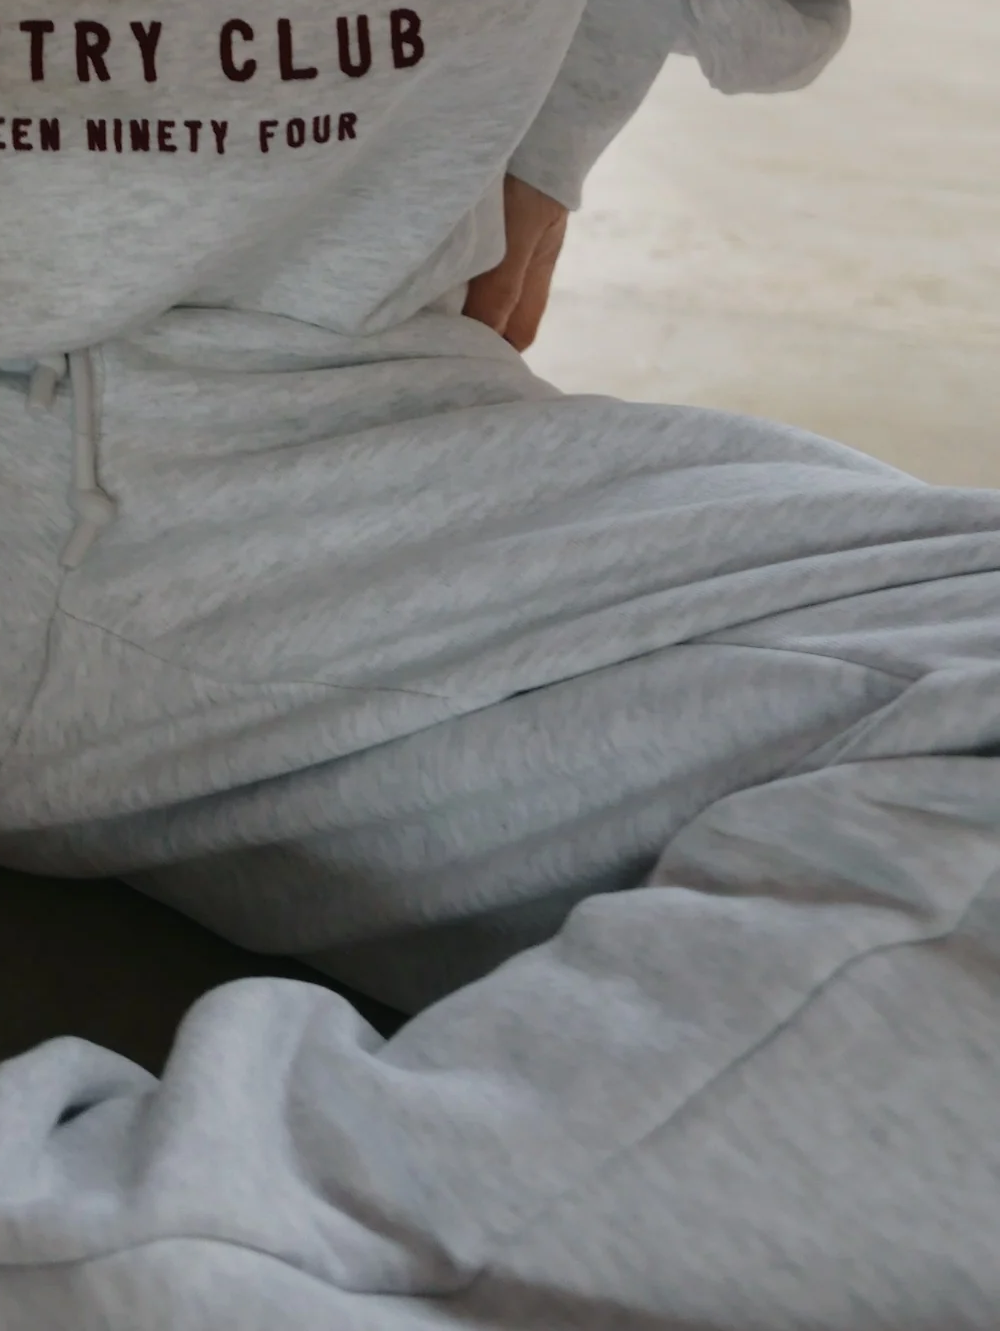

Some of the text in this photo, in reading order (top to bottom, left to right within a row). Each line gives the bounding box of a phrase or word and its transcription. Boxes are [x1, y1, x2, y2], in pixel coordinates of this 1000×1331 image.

[218, 6, 427, 84] CLUB
[84, 117, 230, 156] NINETY
[258, 110, 359, 155] FOUR
